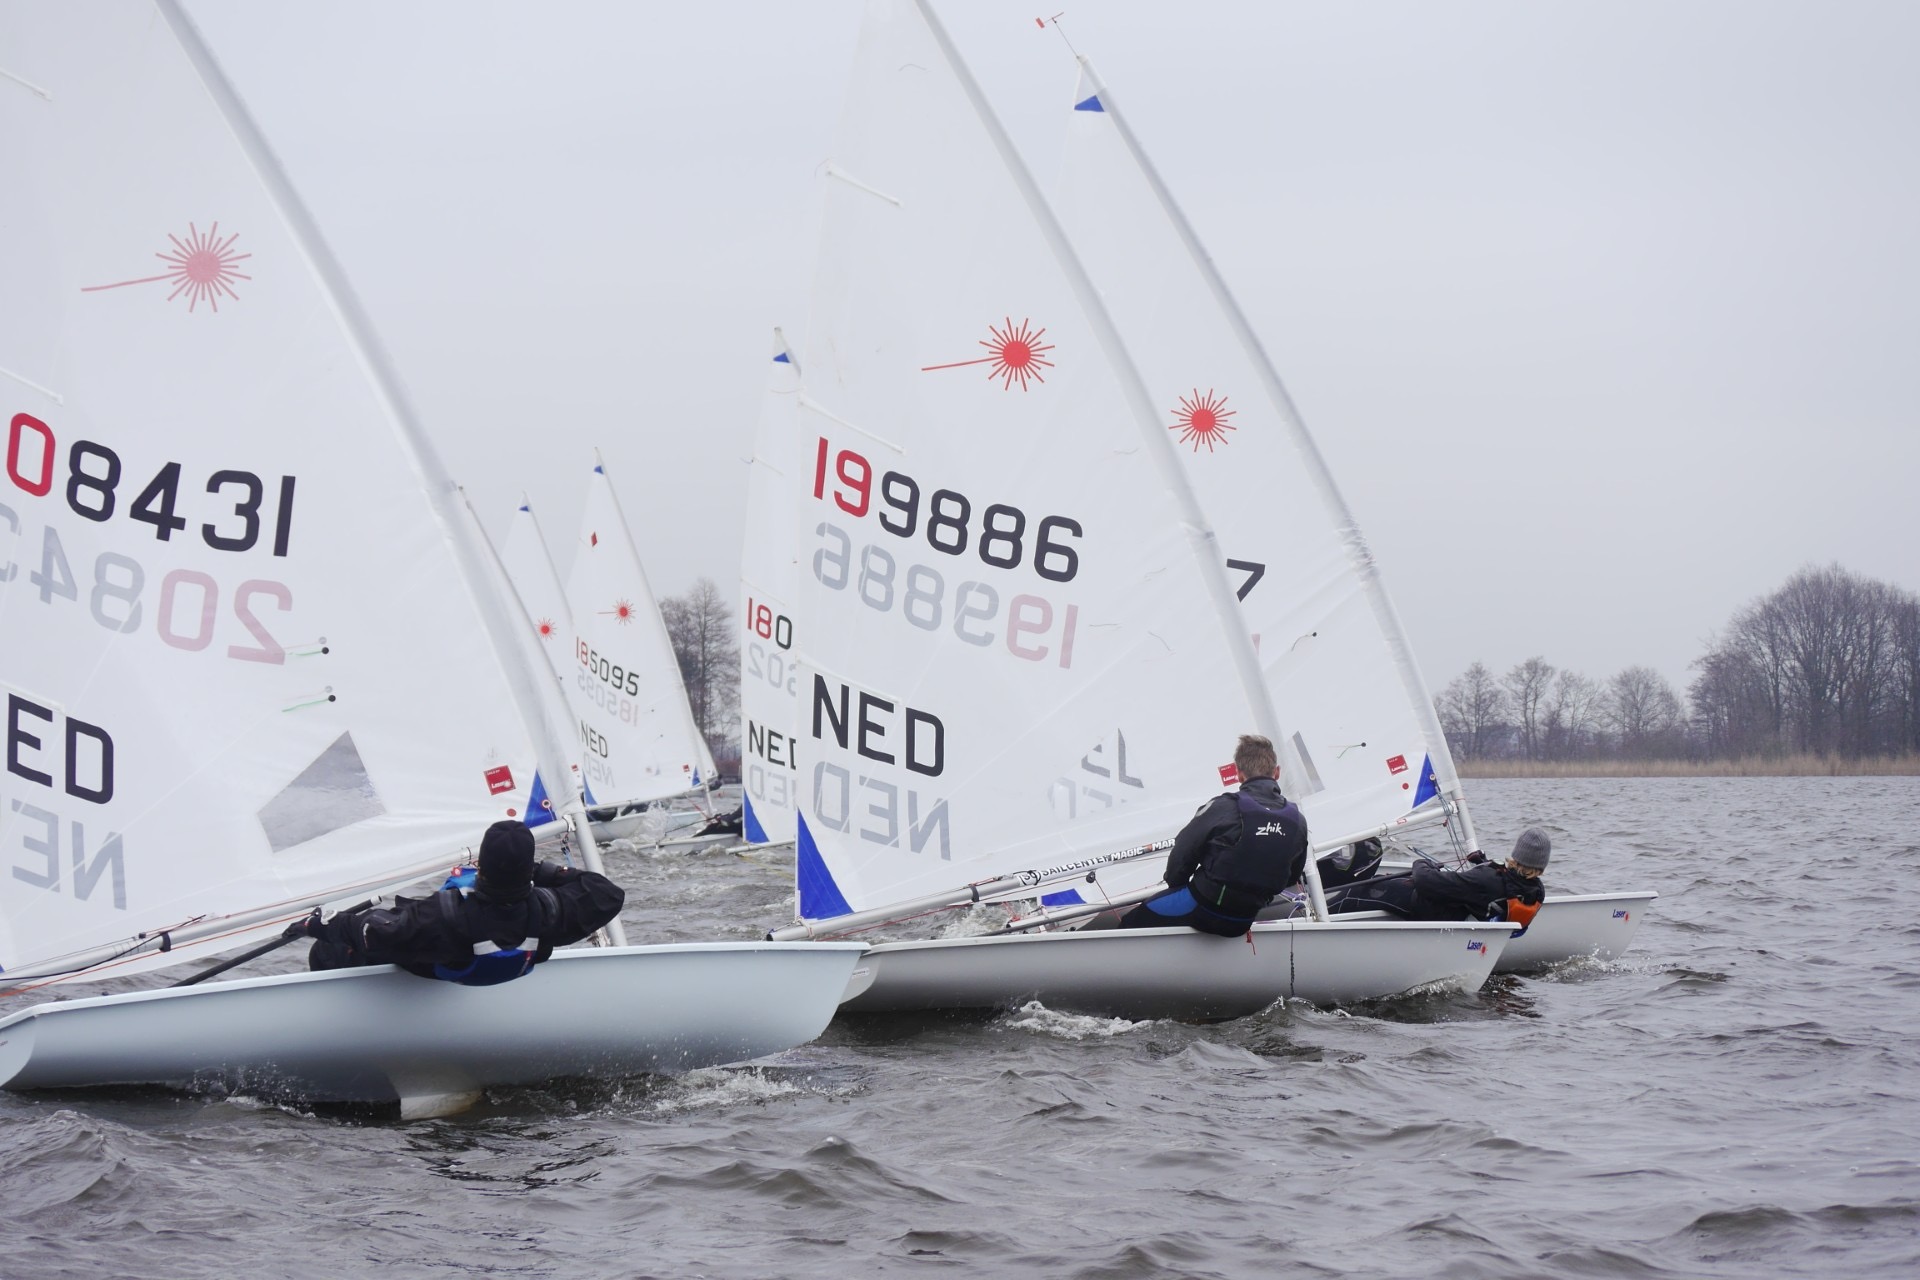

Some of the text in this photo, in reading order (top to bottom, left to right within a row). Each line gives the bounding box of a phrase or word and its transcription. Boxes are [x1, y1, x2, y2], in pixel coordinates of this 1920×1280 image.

[813, 436, 1083, 583] 199886
[576, 636, 640, 697] 185095
[7, 693, 114, 805] ED
[580, 719, 609, 759] NED
[812, 673, 945, 777] NED
[1110, 846, 1144, 862] MAGIC
[1612, 909, 1626, 918] Laser
[1467, 940, 1483, 950] Laser
